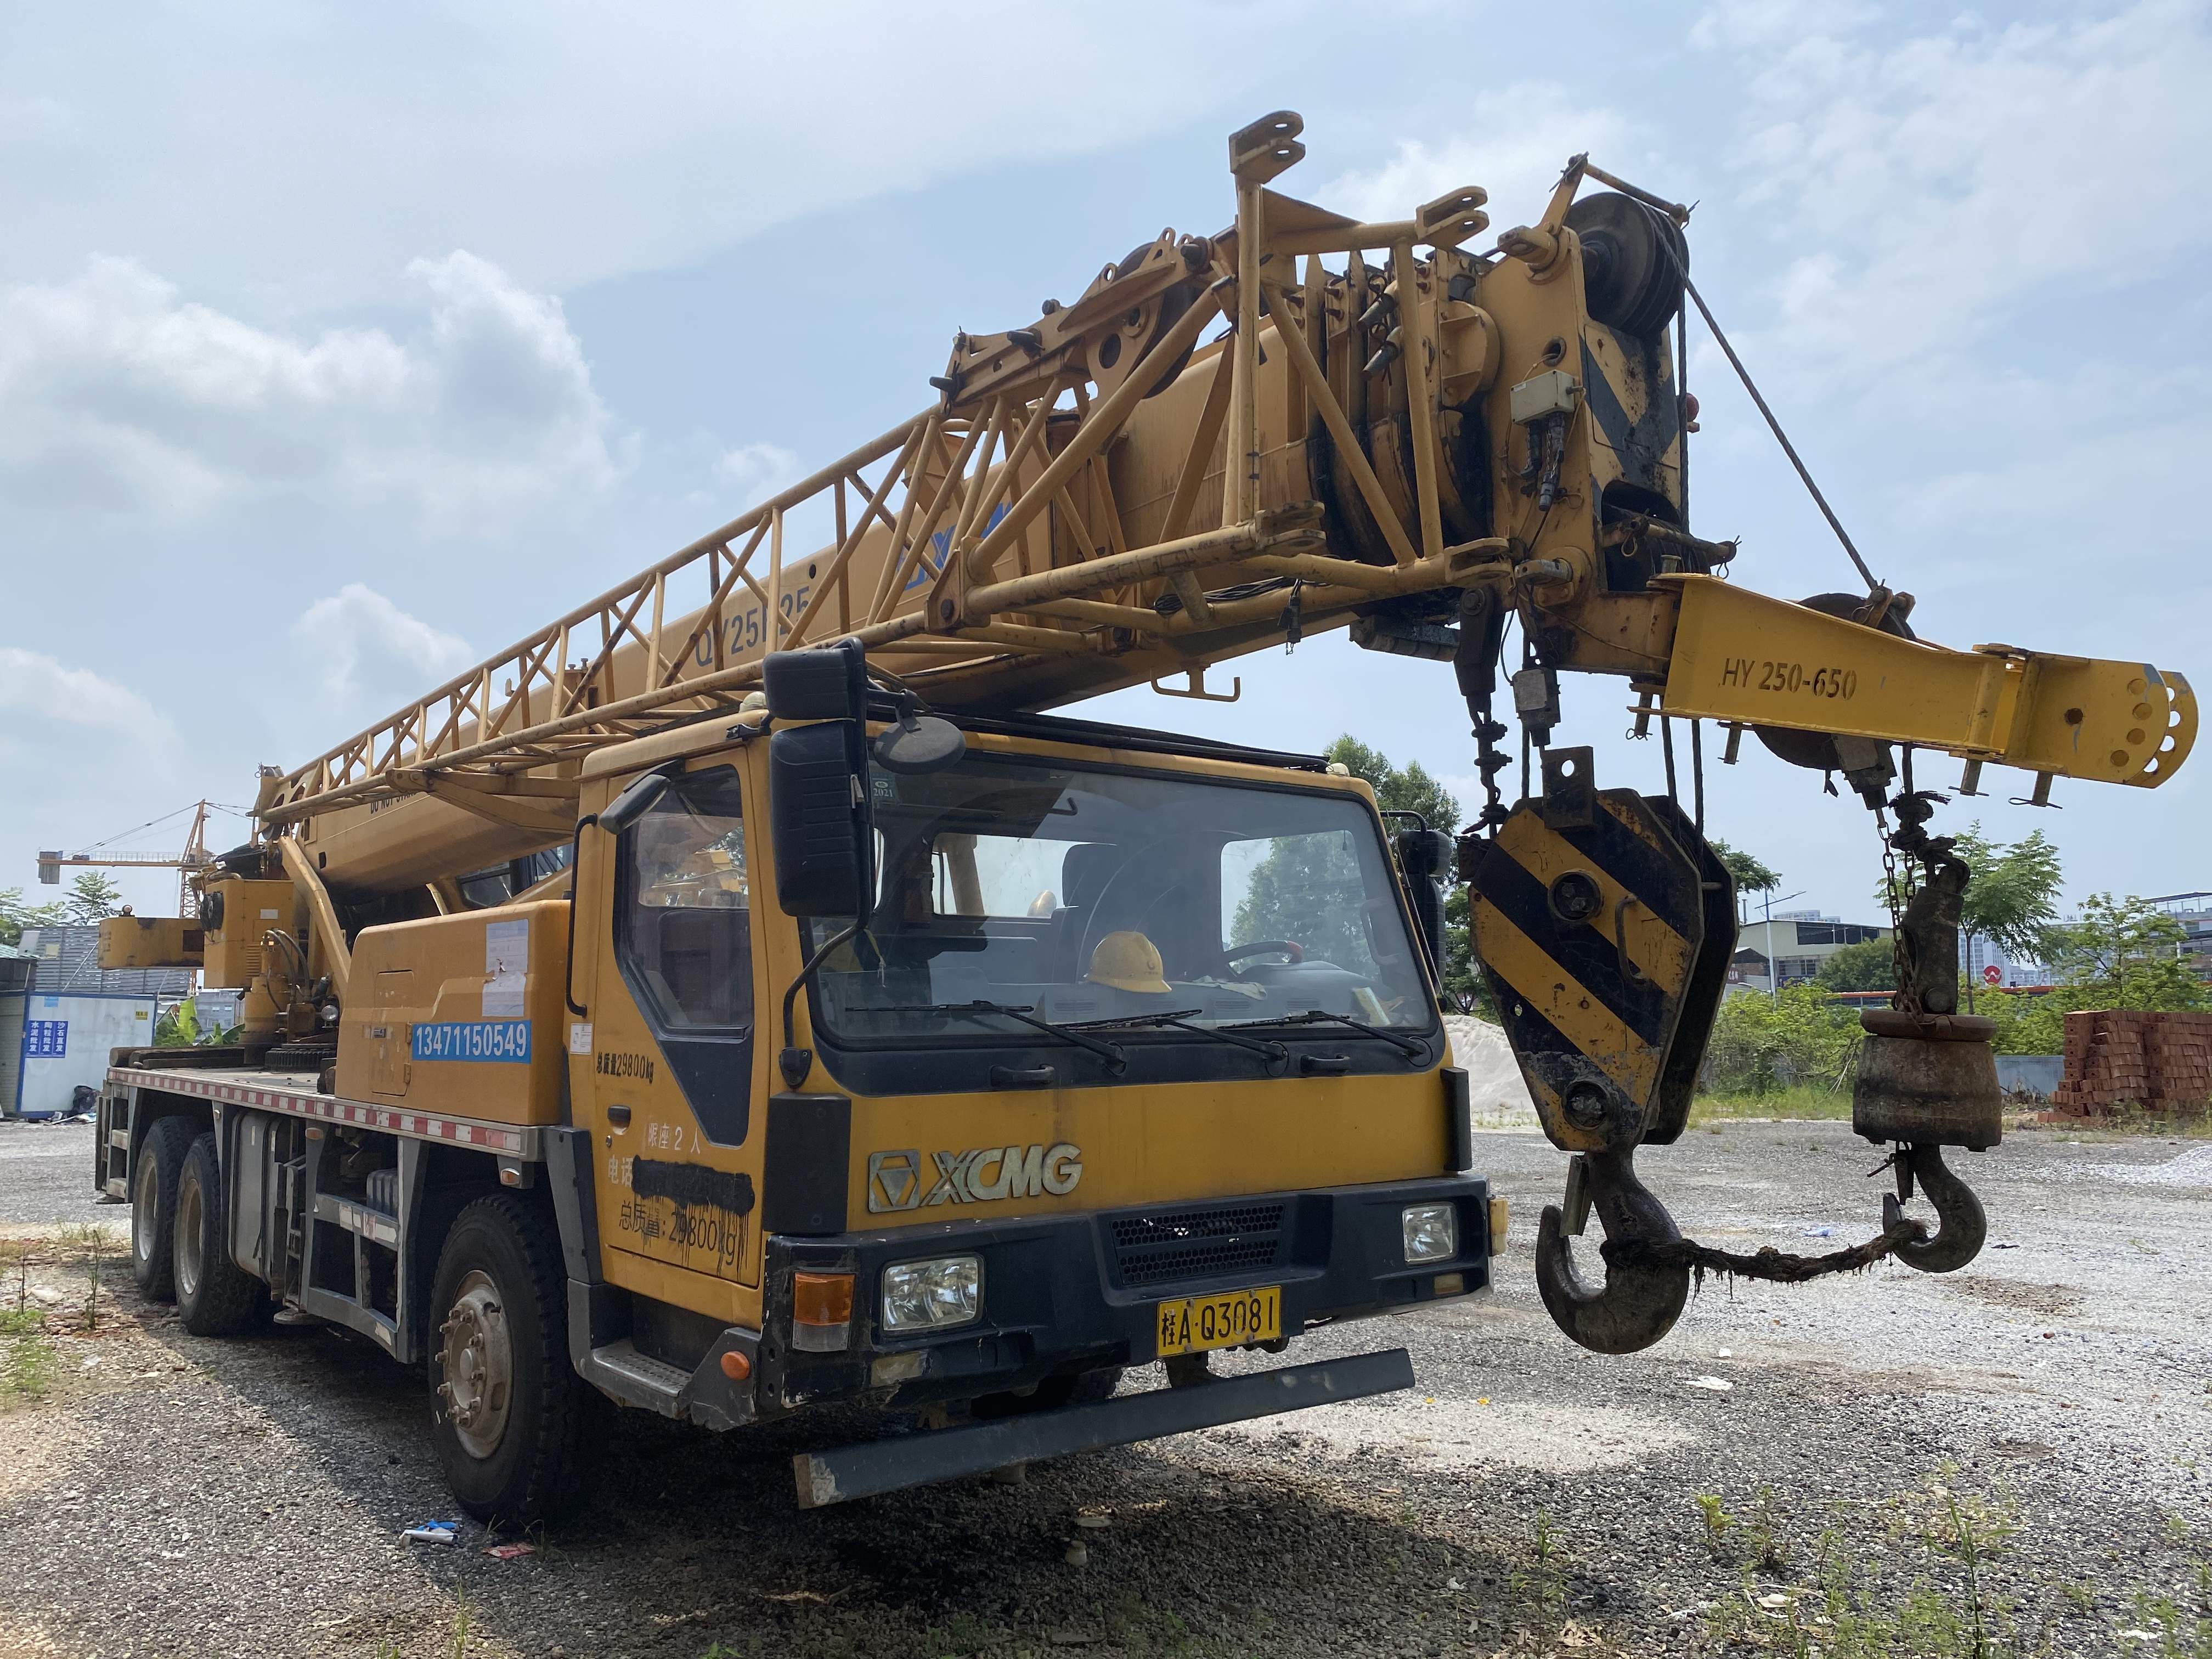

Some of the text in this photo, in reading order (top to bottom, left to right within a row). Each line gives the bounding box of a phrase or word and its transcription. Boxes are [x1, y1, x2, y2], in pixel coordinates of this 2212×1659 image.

[1722, 658, 1857, 701] HY 250-650
[873, 788, 893, 797] 2021
[29, 1022, 40, 1052] 水泥批发
[55, 1022, 66, 1052] 沙石直发
[416, 1023, 527, 1057] 13471150549
[596, 1051, 654, 1085] 总质量29800kg
[608, 1154, 634, 1188] 电话
[920, 1143, 1084, 1207] XCMG
